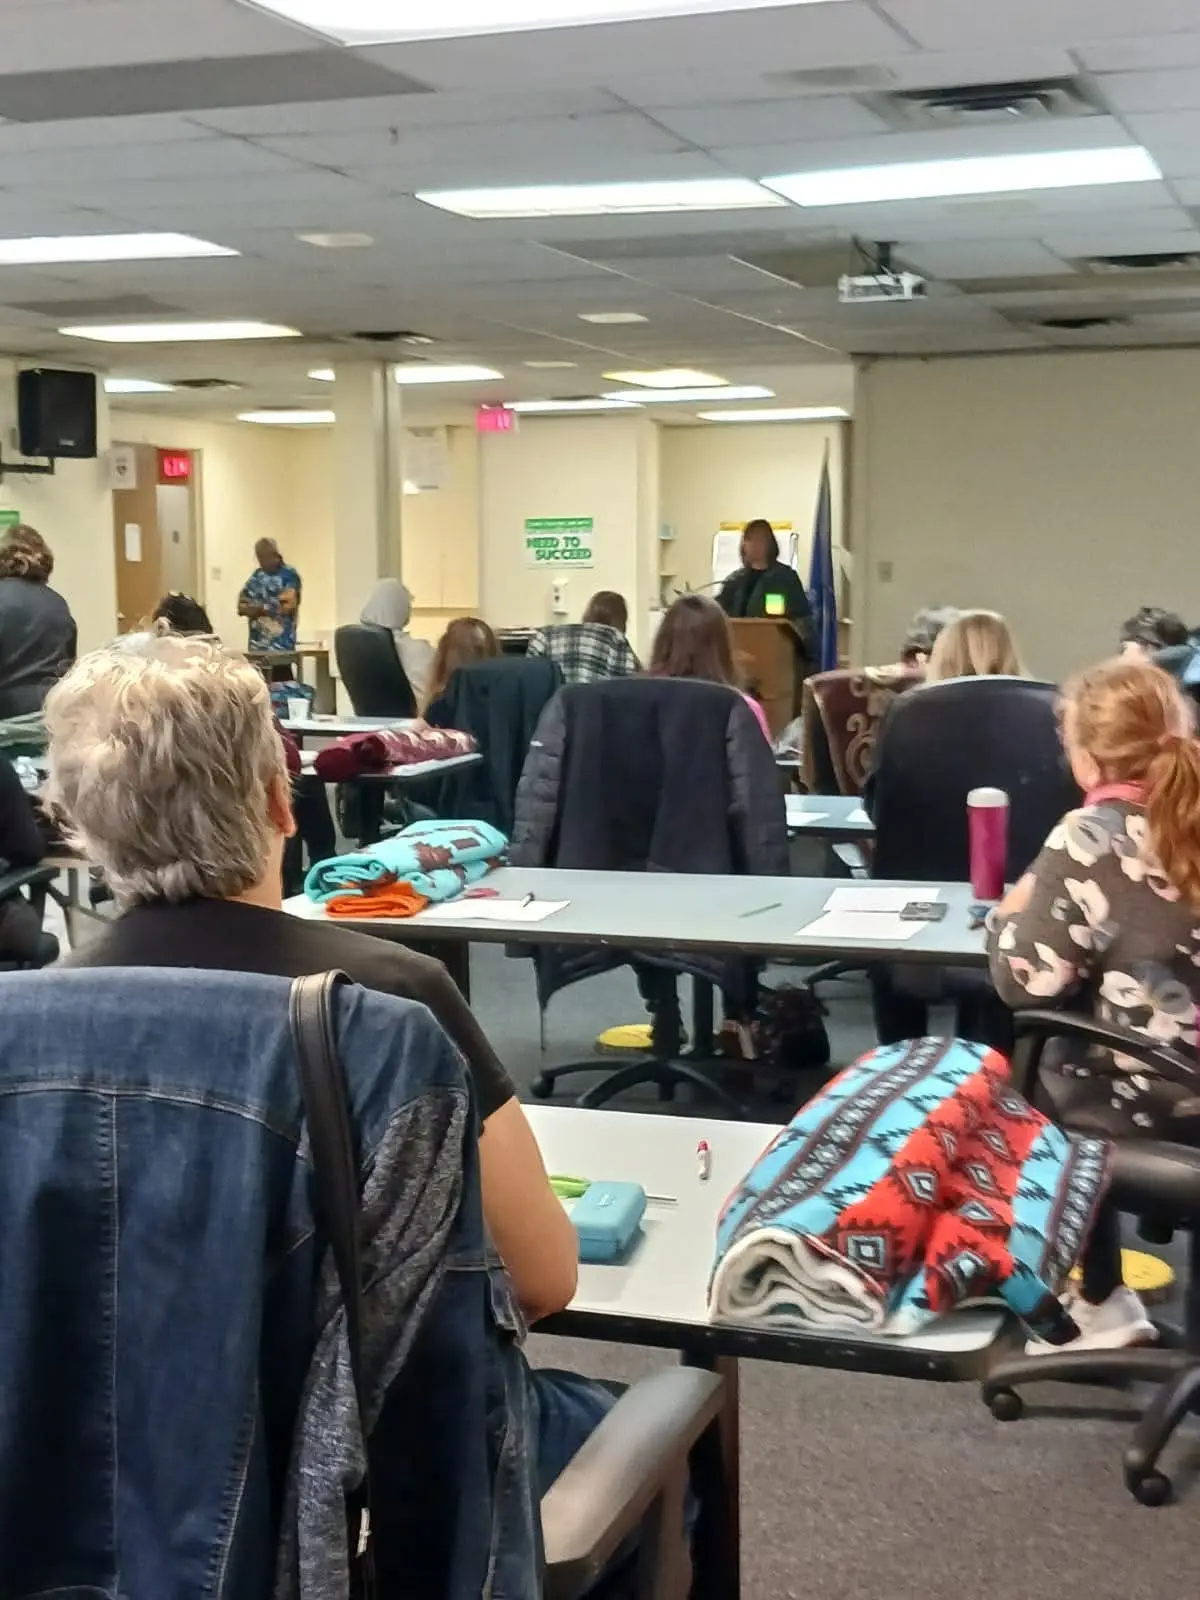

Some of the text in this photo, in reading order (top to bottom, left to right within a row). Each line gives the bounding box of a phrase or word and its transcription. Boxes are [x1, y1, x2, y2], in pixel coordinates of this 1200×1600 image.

[527, 536, 580, 548] NEED TO
[536, 548, 591, 560] SUCCEED
